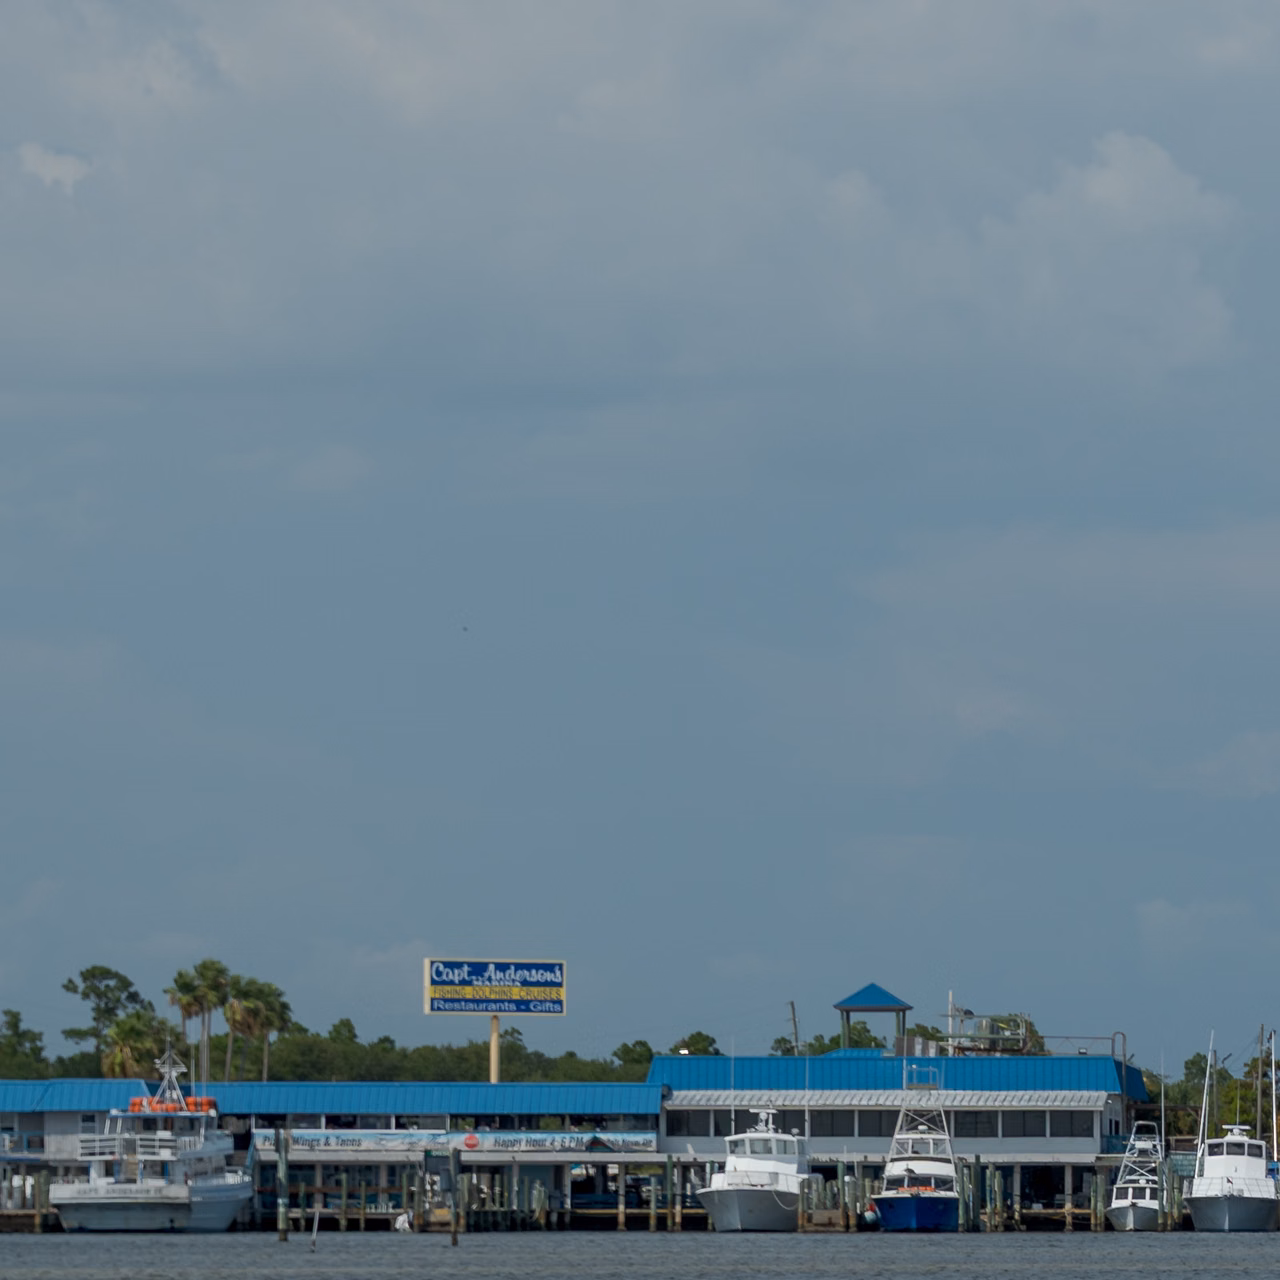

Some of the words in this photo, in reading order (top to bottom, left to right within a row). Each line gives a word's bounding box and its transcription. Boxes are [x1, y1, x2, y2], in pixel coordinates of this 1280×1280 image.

[519, 988, 562, 1000] CRUISES
[433, 1000, 516, 1011] Restaurants
[529, 1001, 562, 1012] Gifts
